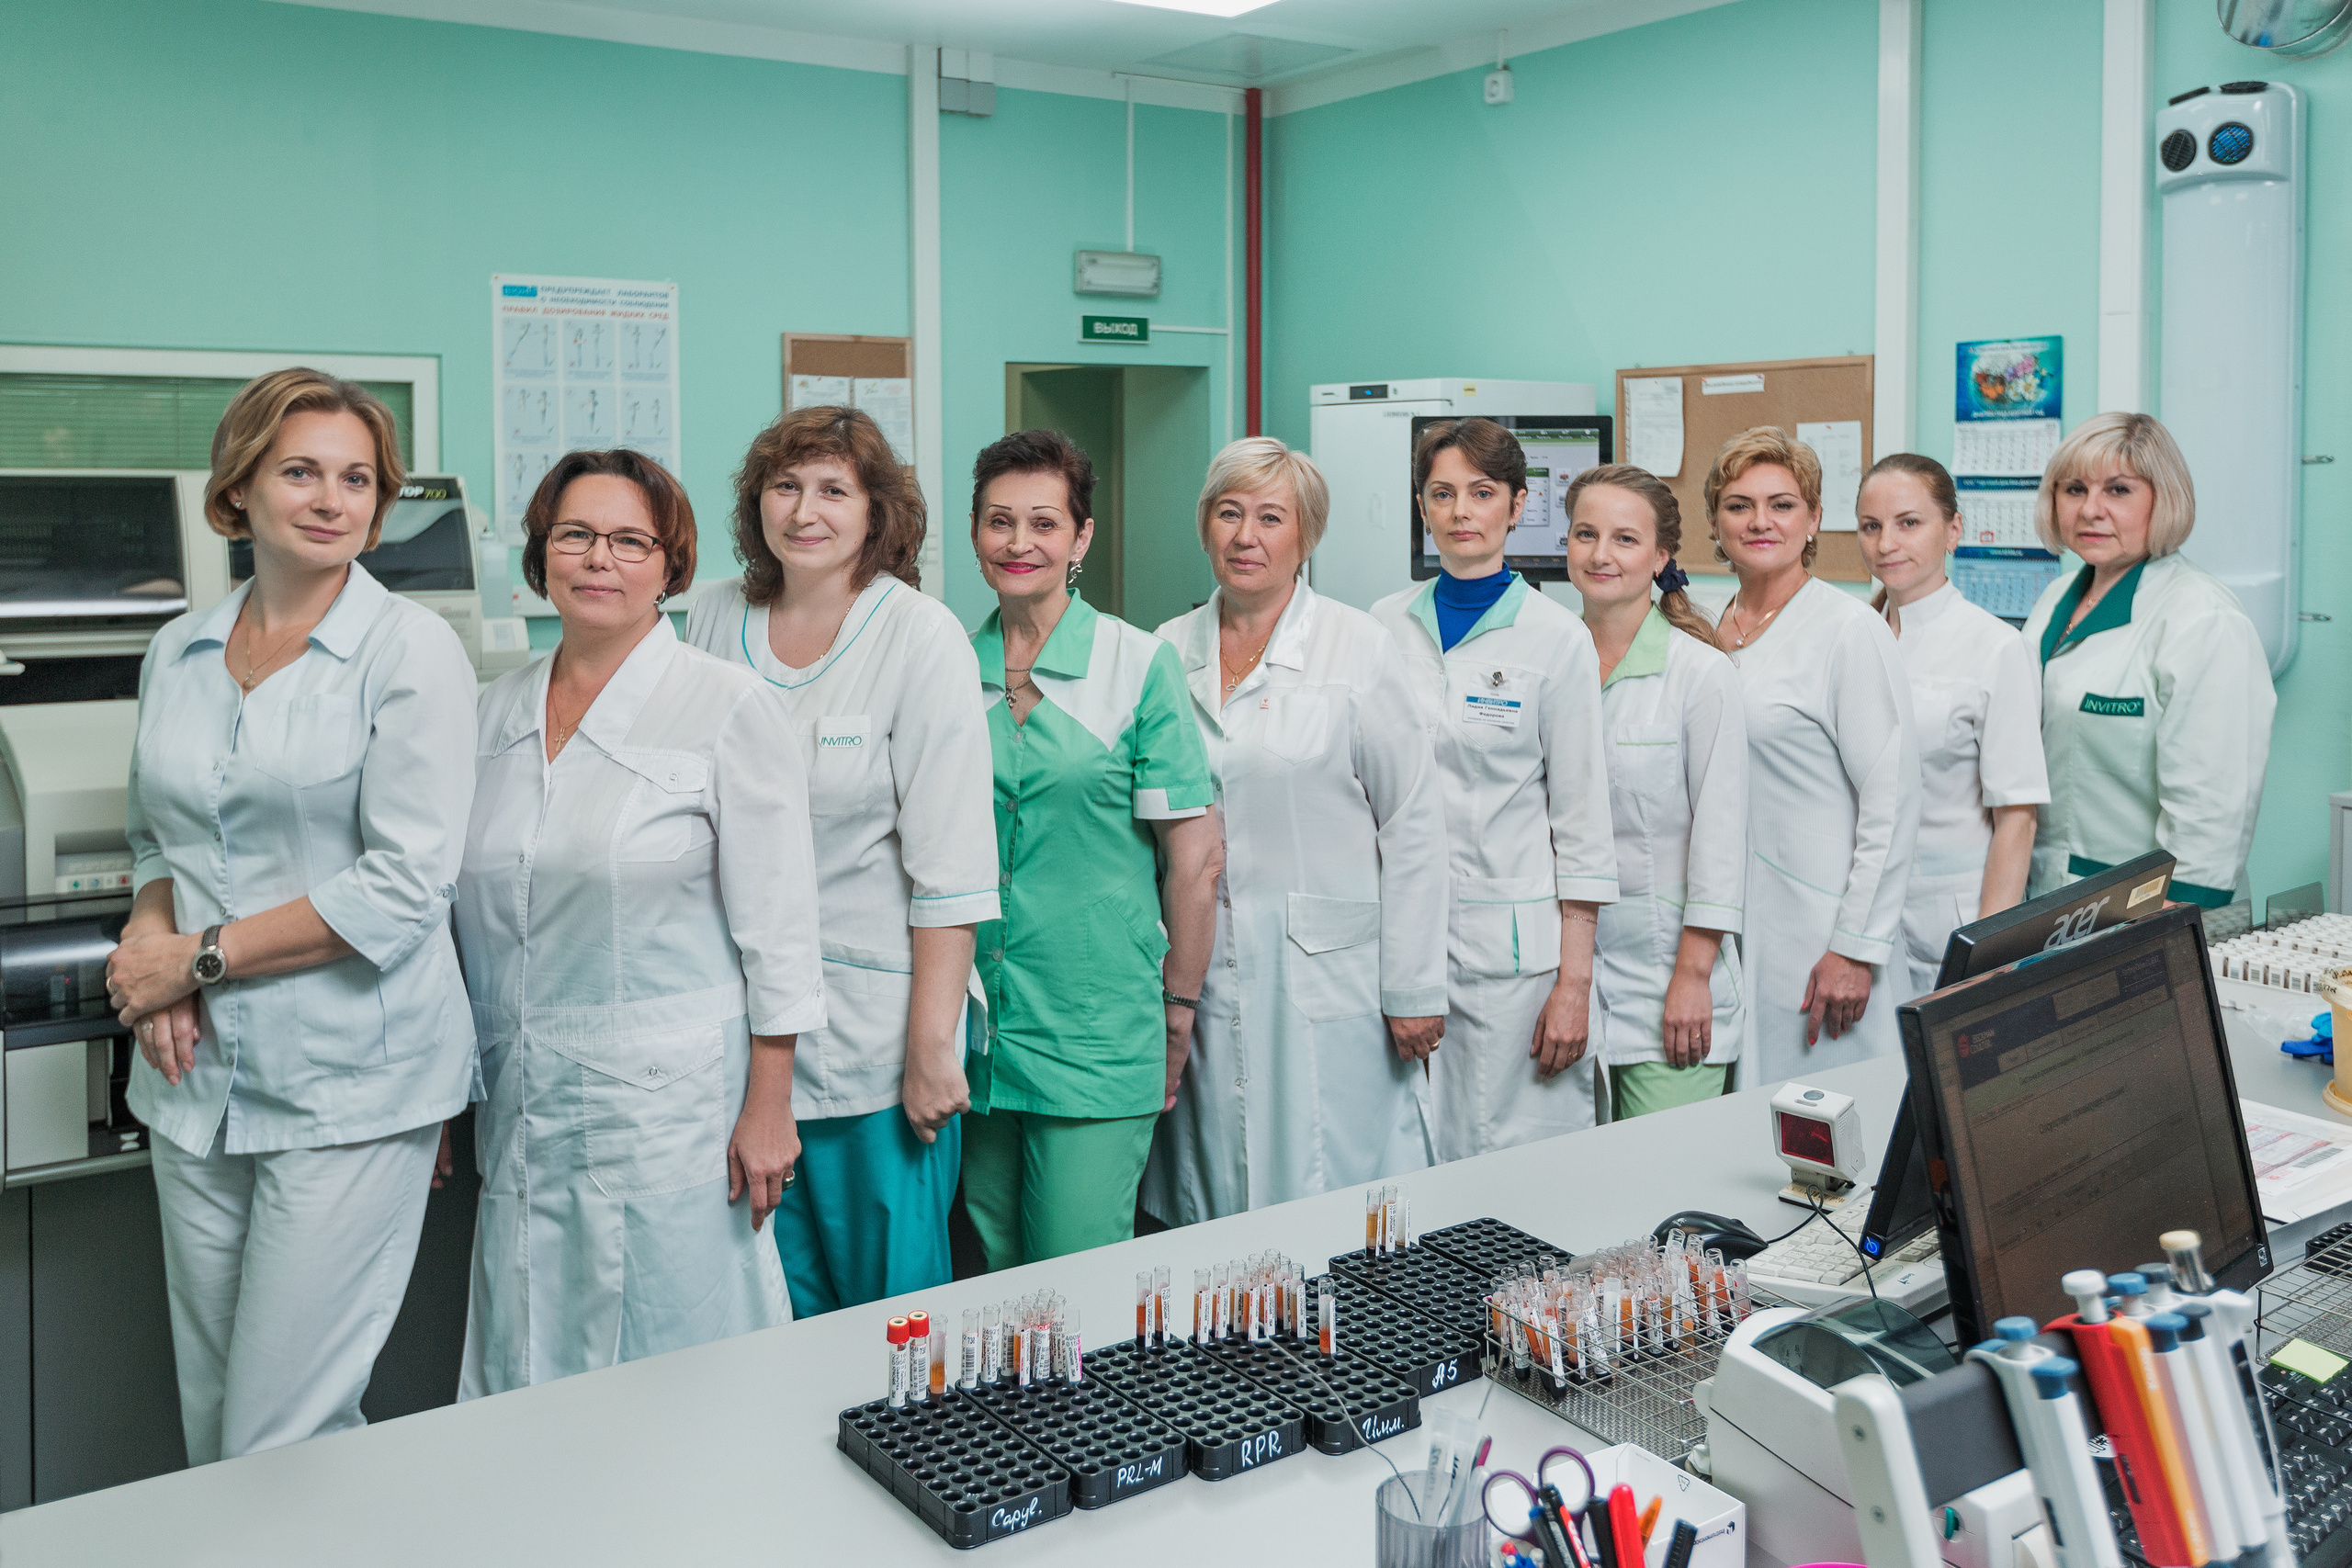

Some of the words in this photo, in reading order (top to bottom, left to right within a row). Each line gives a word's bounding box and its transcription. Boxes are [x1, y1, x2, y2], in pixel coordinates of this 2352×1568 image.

[1093, 321, 1138, 336] ВЫХОД
[2085, 699, 2138, 714] INVITRO
[821, 736, 862, 746] INVITRO
[2043, 896, 2110, 951] acer
[1241, 1430, 1283, 1468] RPR
[1117, 1455, 1163, 1488] PRL-M
